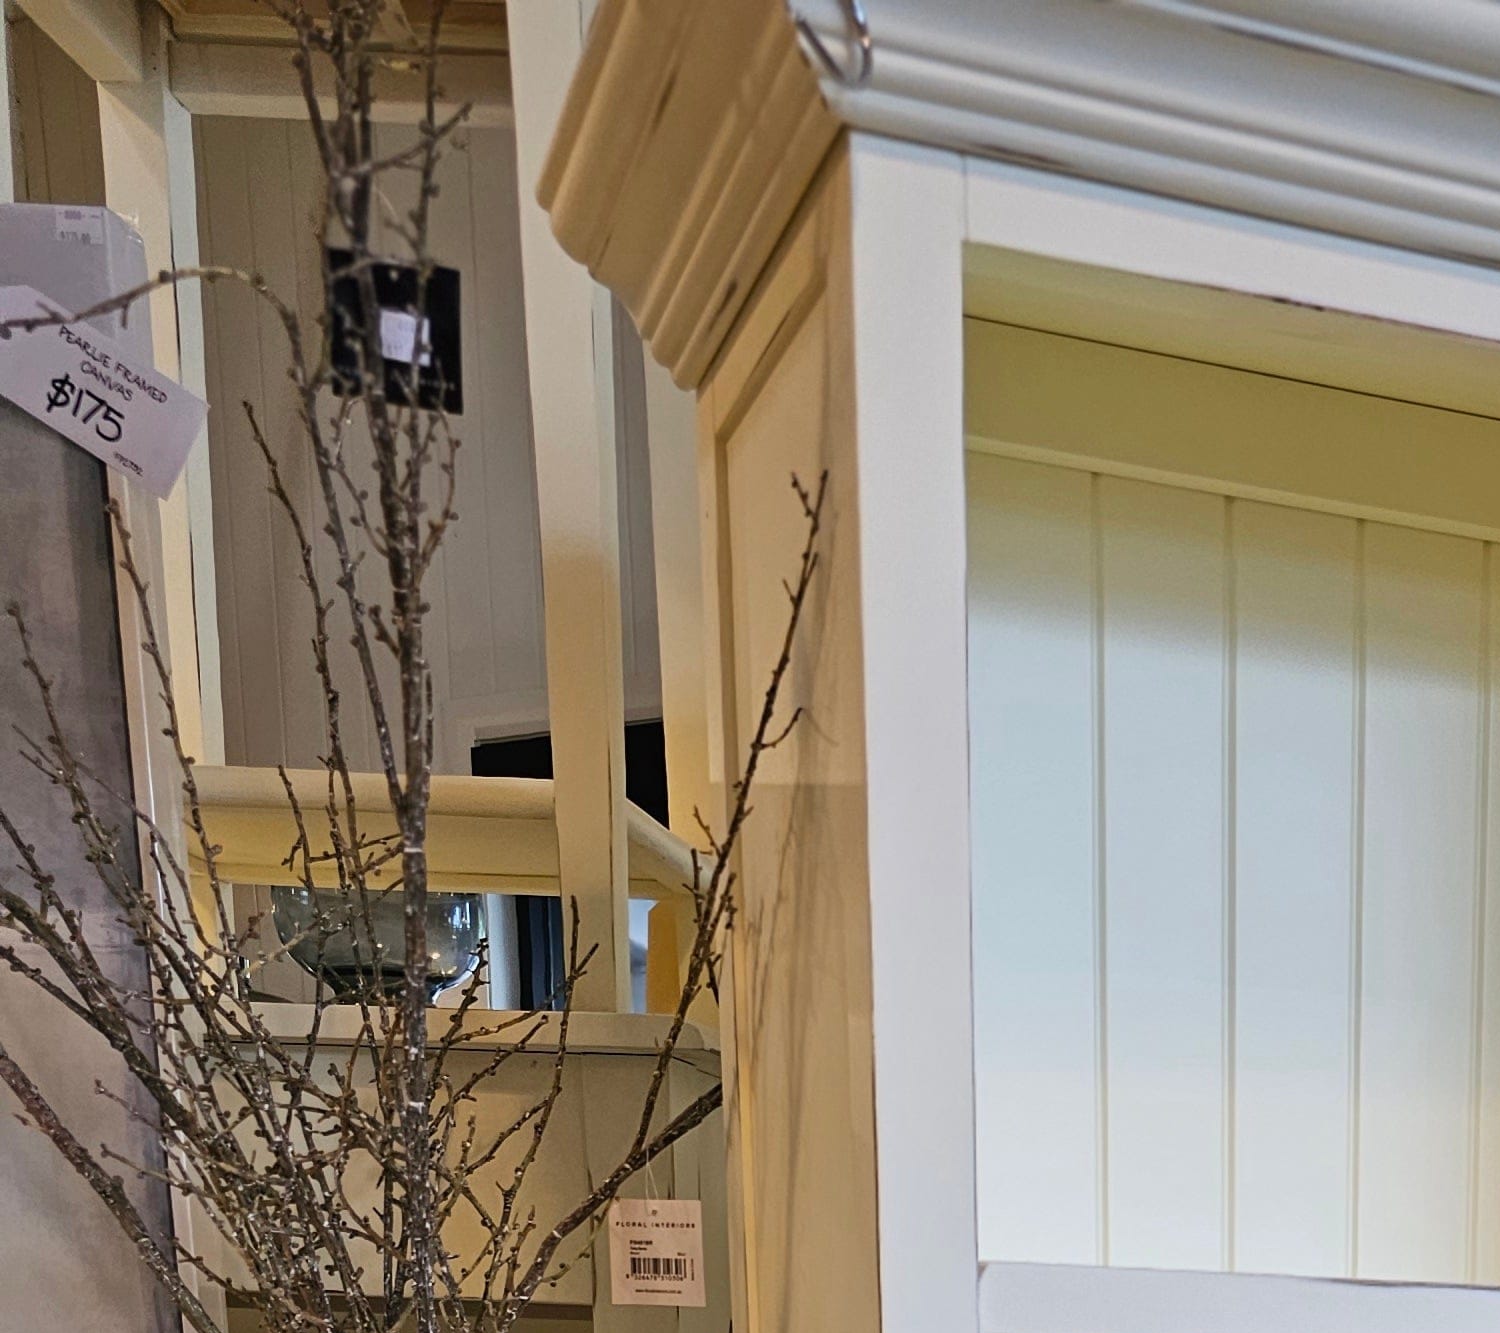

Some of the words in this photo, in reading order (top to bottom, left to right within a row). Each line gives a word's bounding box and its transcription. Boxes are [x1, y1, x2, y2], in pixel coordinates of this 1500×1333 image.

[58, 325, 110, 368] PEARLIE
[114, 362, 168, 404] FRAMED
[80, 360, 134, 402] CANVAS
[47, 373, 125, 443] $175
